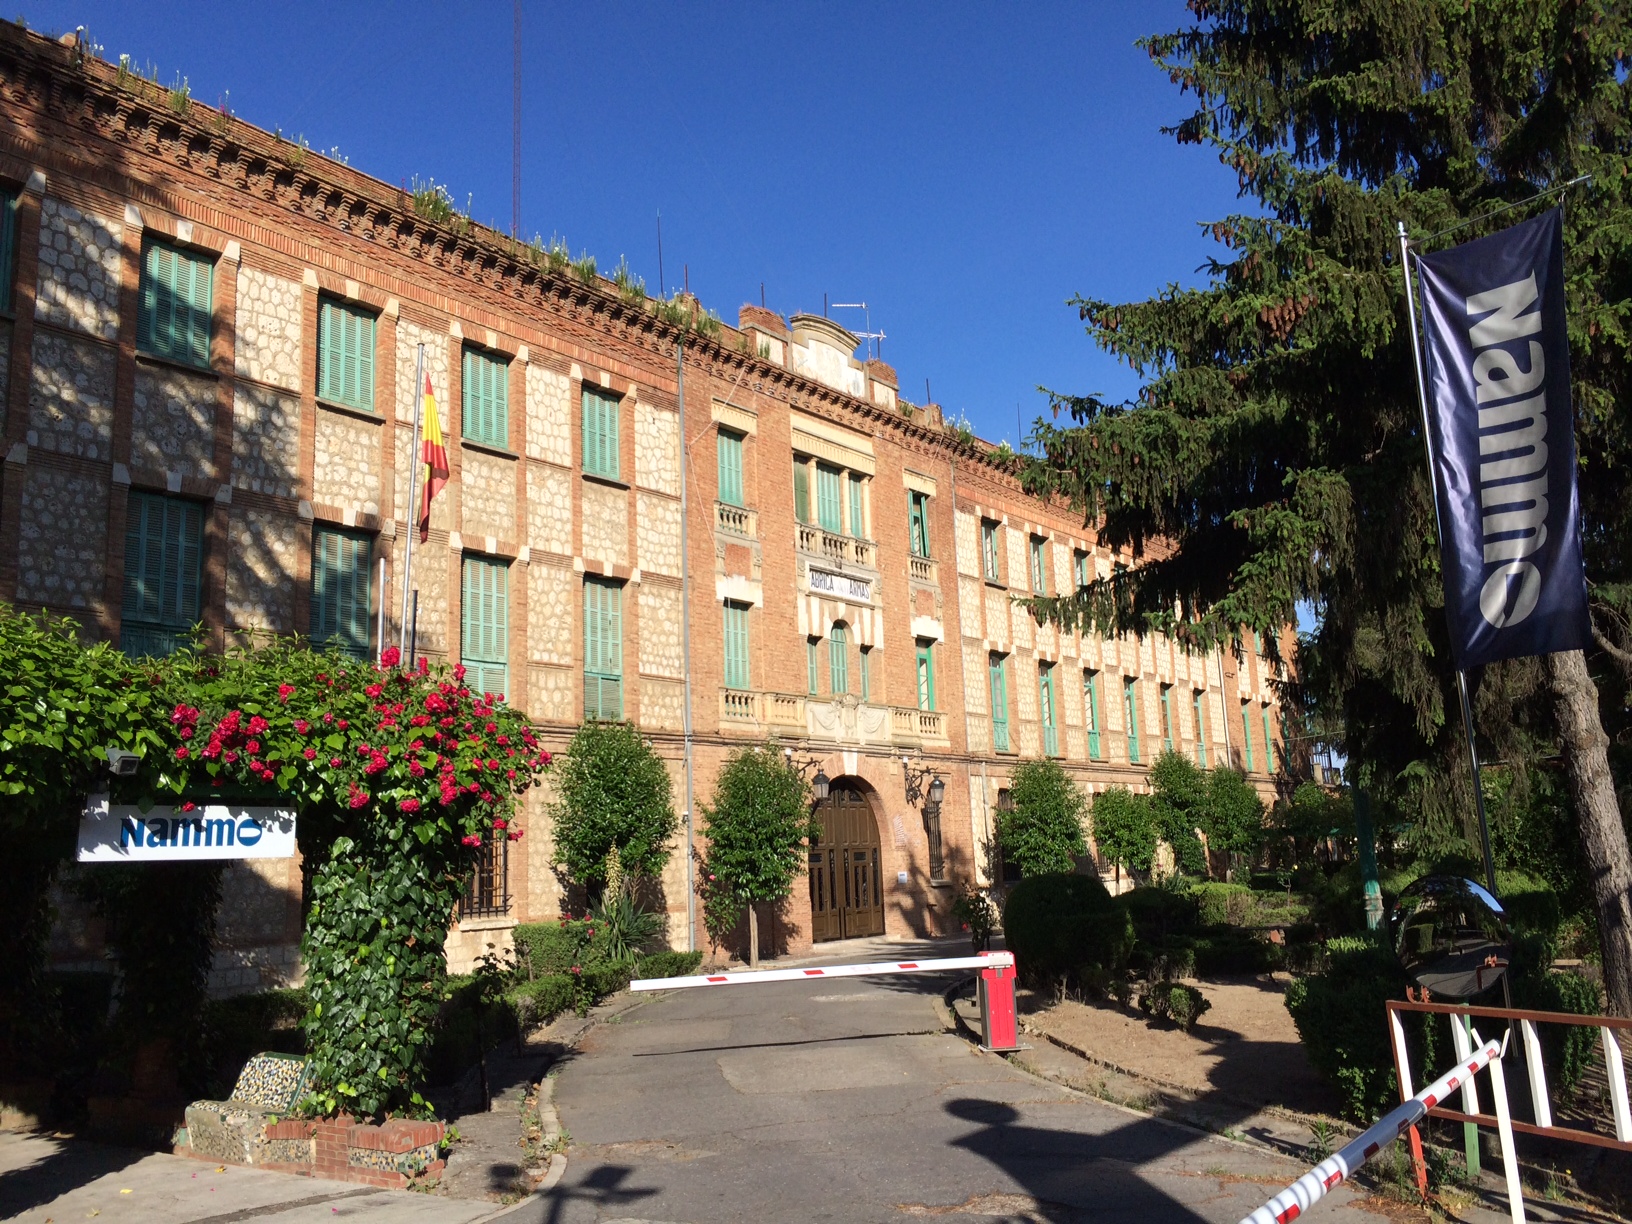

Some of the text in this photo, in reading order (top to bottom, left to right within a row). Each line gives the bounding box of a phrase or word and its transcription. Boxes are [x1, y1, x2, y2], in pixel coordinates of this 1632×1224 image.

[1465, 269, 1549, 629] Nammo
[849, 579, 870, 600] ARMAS
[119, 816, 263, 848] Nammo
